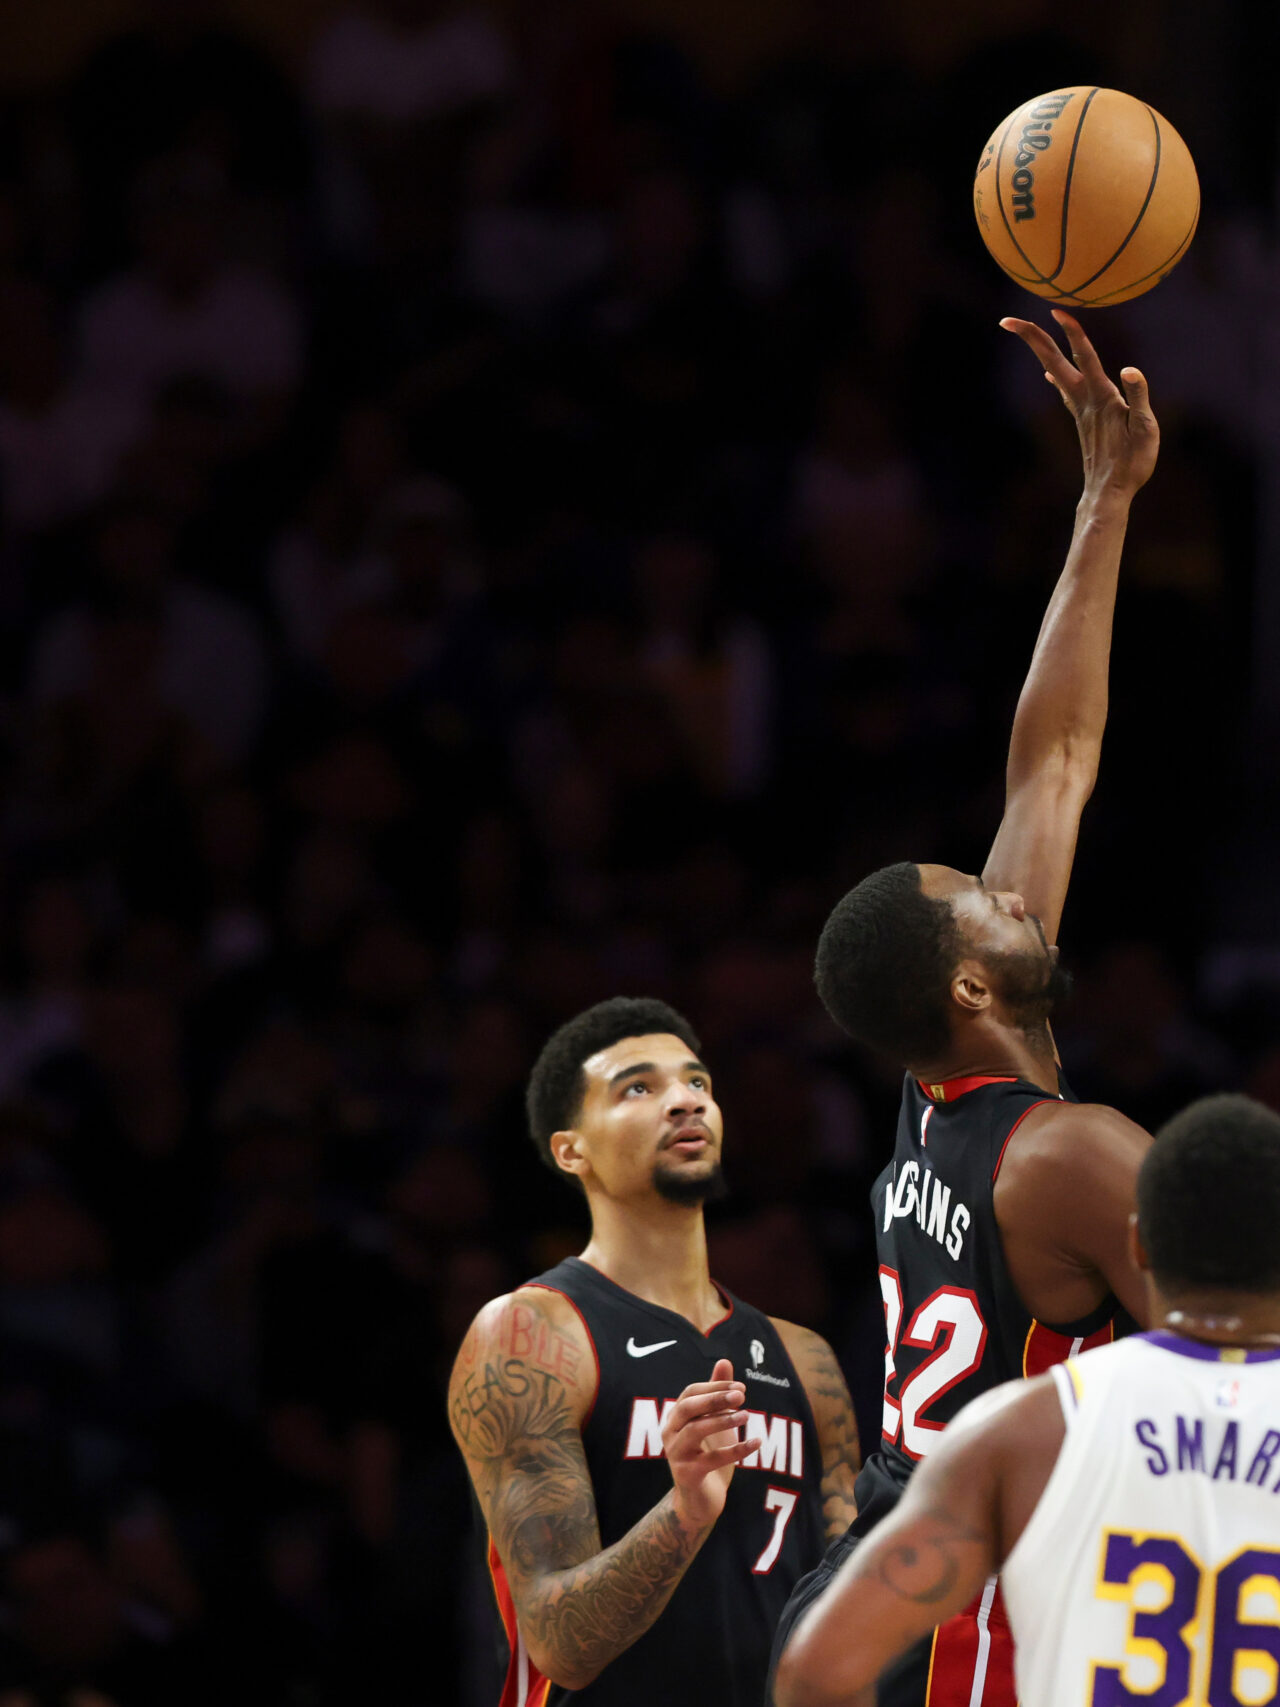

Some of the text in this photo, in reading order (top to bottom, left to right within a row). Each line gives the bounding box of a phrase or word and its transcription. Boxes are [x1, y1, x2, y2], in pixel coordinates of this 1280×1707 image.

[1012, 93, 1076, 223] Wilson
[878, 1264, 988, 1460] 22
[624, 1396, 804, 1479] MMI
[752, 1485, 800, 1574] 7
